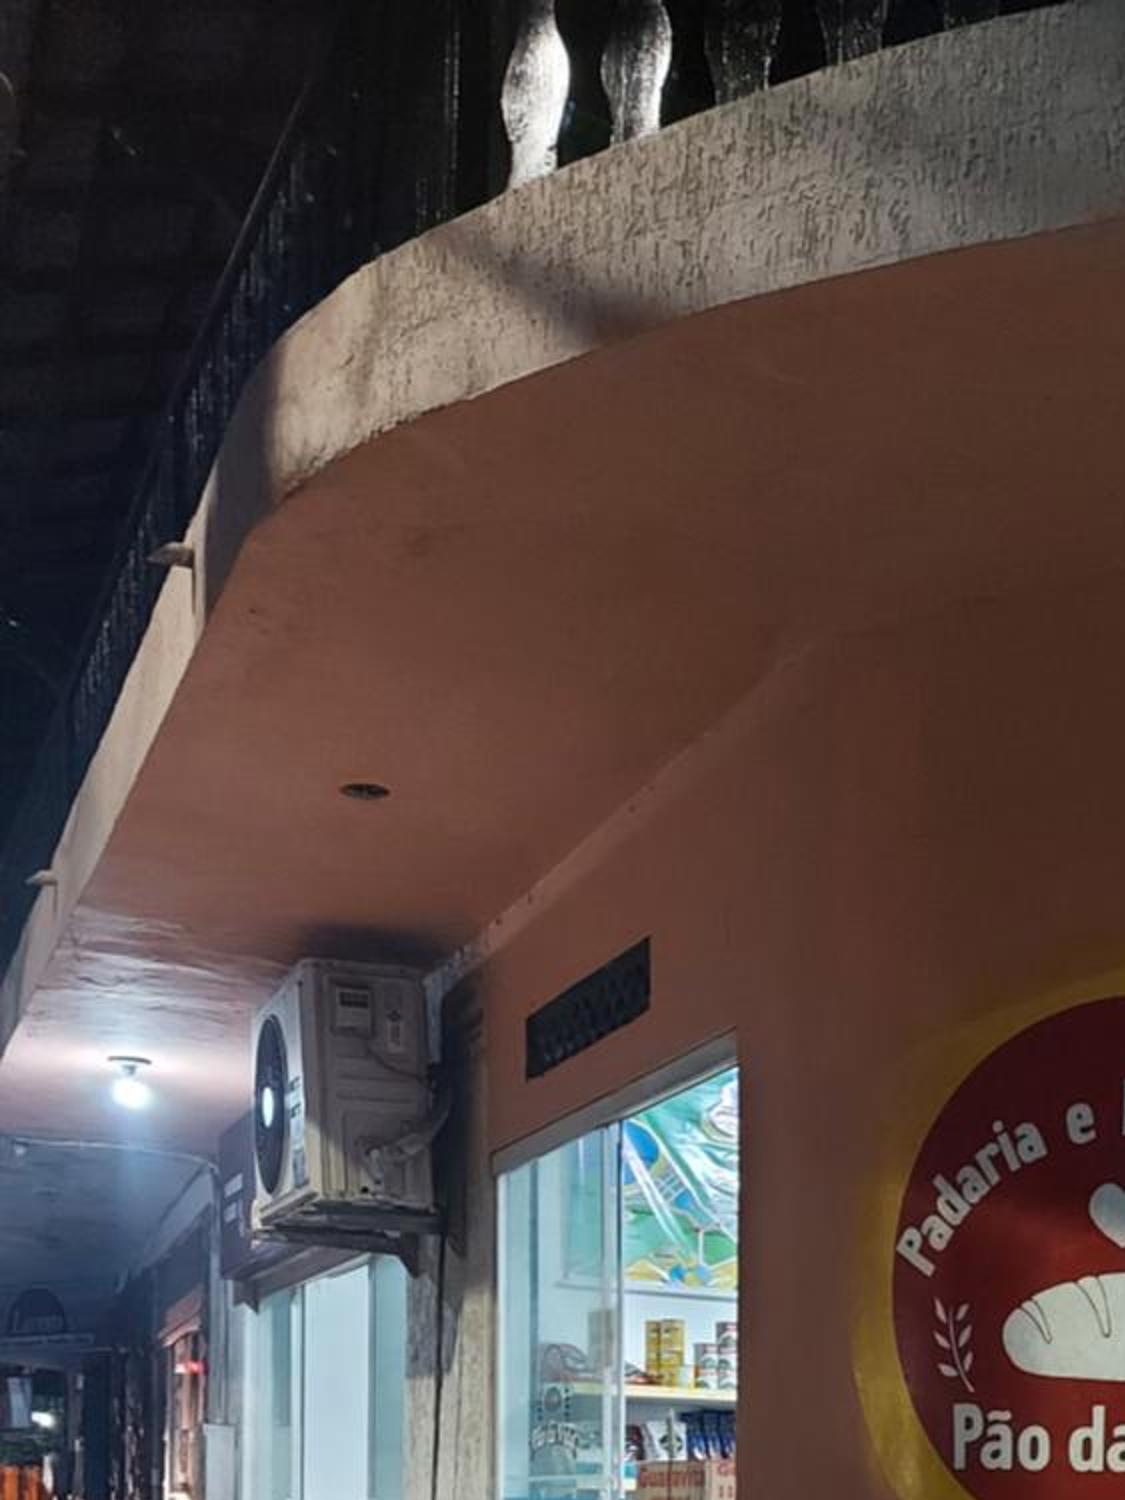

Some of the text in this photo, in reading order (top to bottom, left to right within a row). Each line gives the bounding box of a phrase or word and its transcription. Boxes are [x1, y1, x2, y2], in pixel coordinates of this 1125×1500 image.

[896, 1120, 1048, 1277] Padaria
[1065, 1102, 1097, 1145] e
[953, 1403, 1051, 1472] Pão
